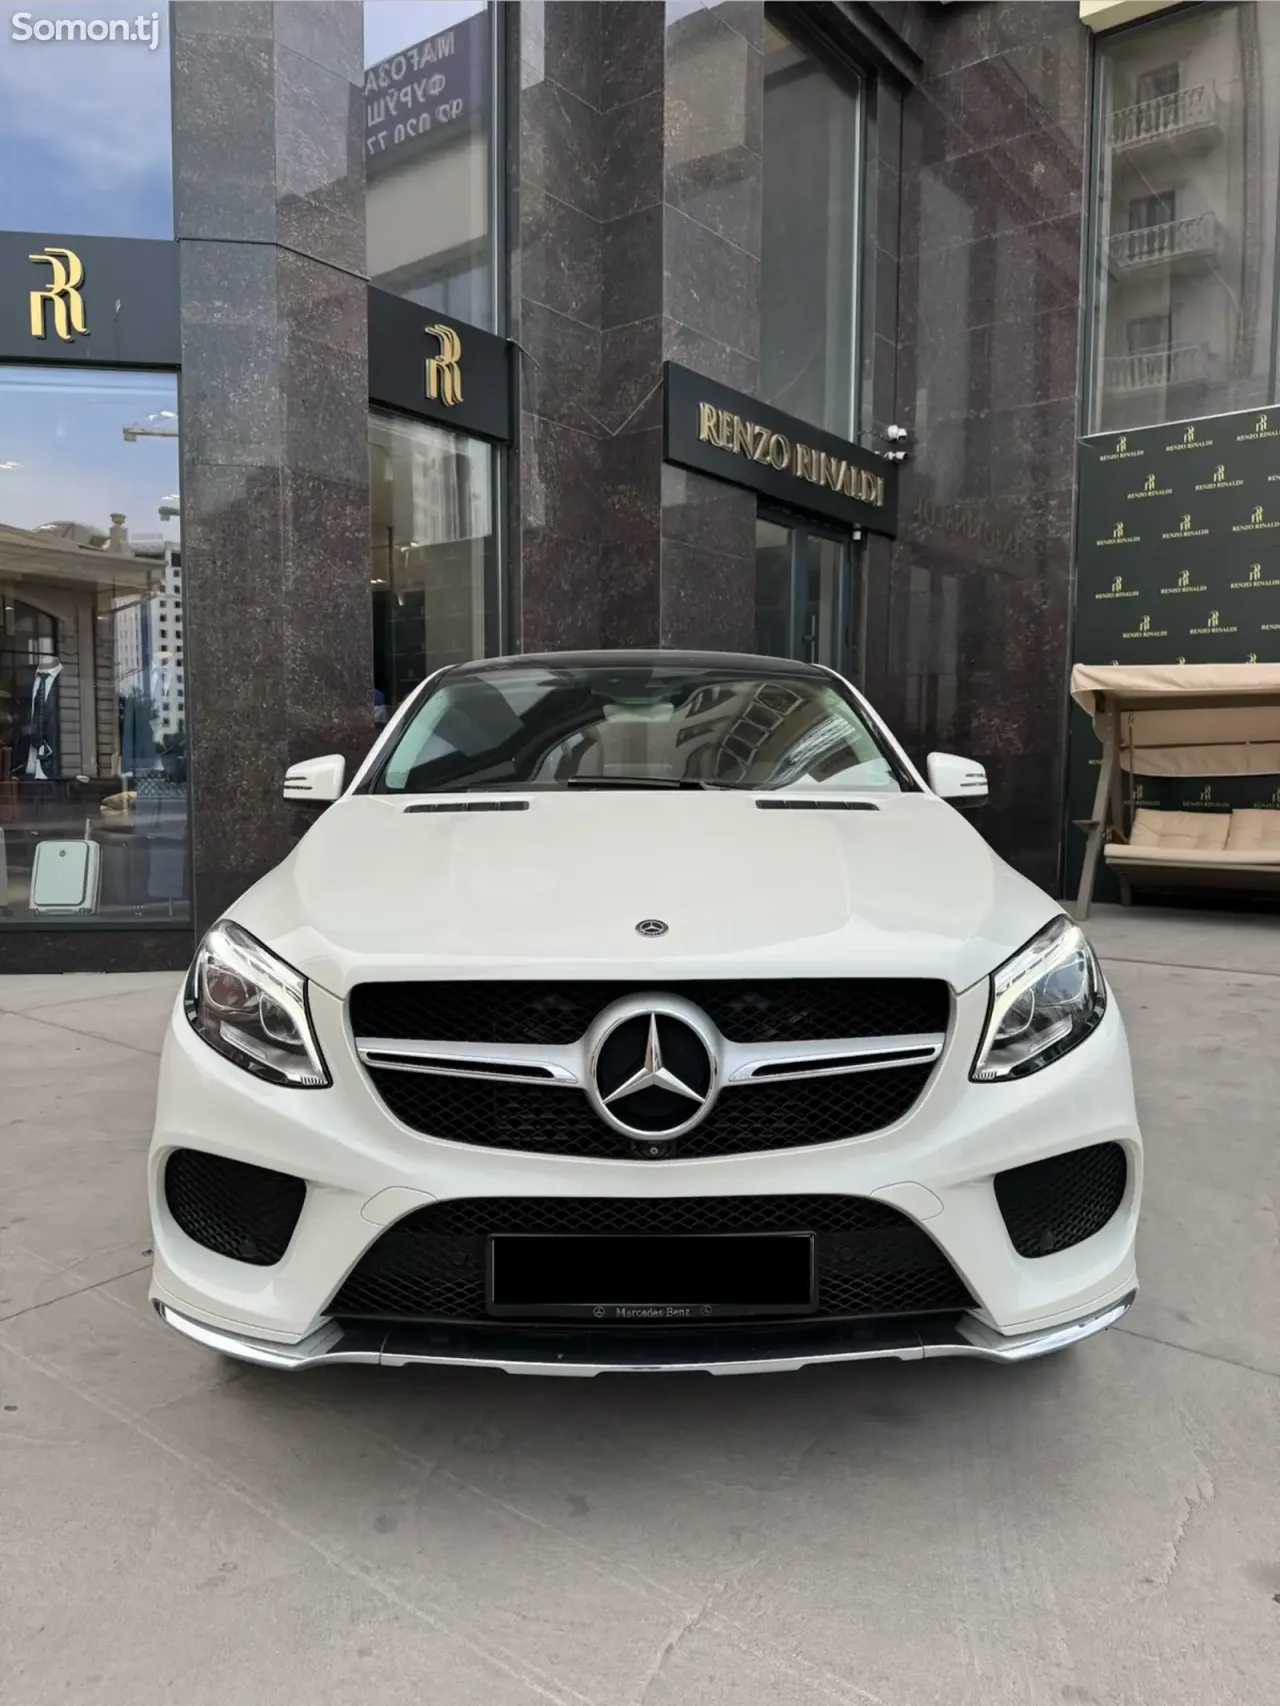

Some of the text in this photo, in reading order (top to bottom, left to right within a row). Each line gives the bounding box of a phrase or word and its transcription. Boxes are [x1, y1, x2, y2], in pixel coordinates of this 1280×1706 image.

[1236, 433, 1259, 442] RENZO
[1166, 440, 1213, 452] RENZO RINALDI
[699, 401, 885, 507] RENZO RINALDI
[1100, 450, 1145, 461] RENZO RINALDI
[1195, 479, 1244, 491] RENZO RINALDI
[1127, 488, 1173, 500] RENZO RINALDI
[1232, 524, 1254, 532] RENZO
[1162, 528, 1209, 539] RENZO RINALDI
[1096, 536, 1141, 546] RENZO RINALDI
[1230, 579, 1280, 590] RENZO RINALDI
[1095, 590, 1140, 600] RENZO RINALDI
[1160, 585, 1207, 595] RENZO RINALDI
[1122, 630, 1168, 639] RENZO RINALDI
[1211, 626, 1238, 634] RINALDI
